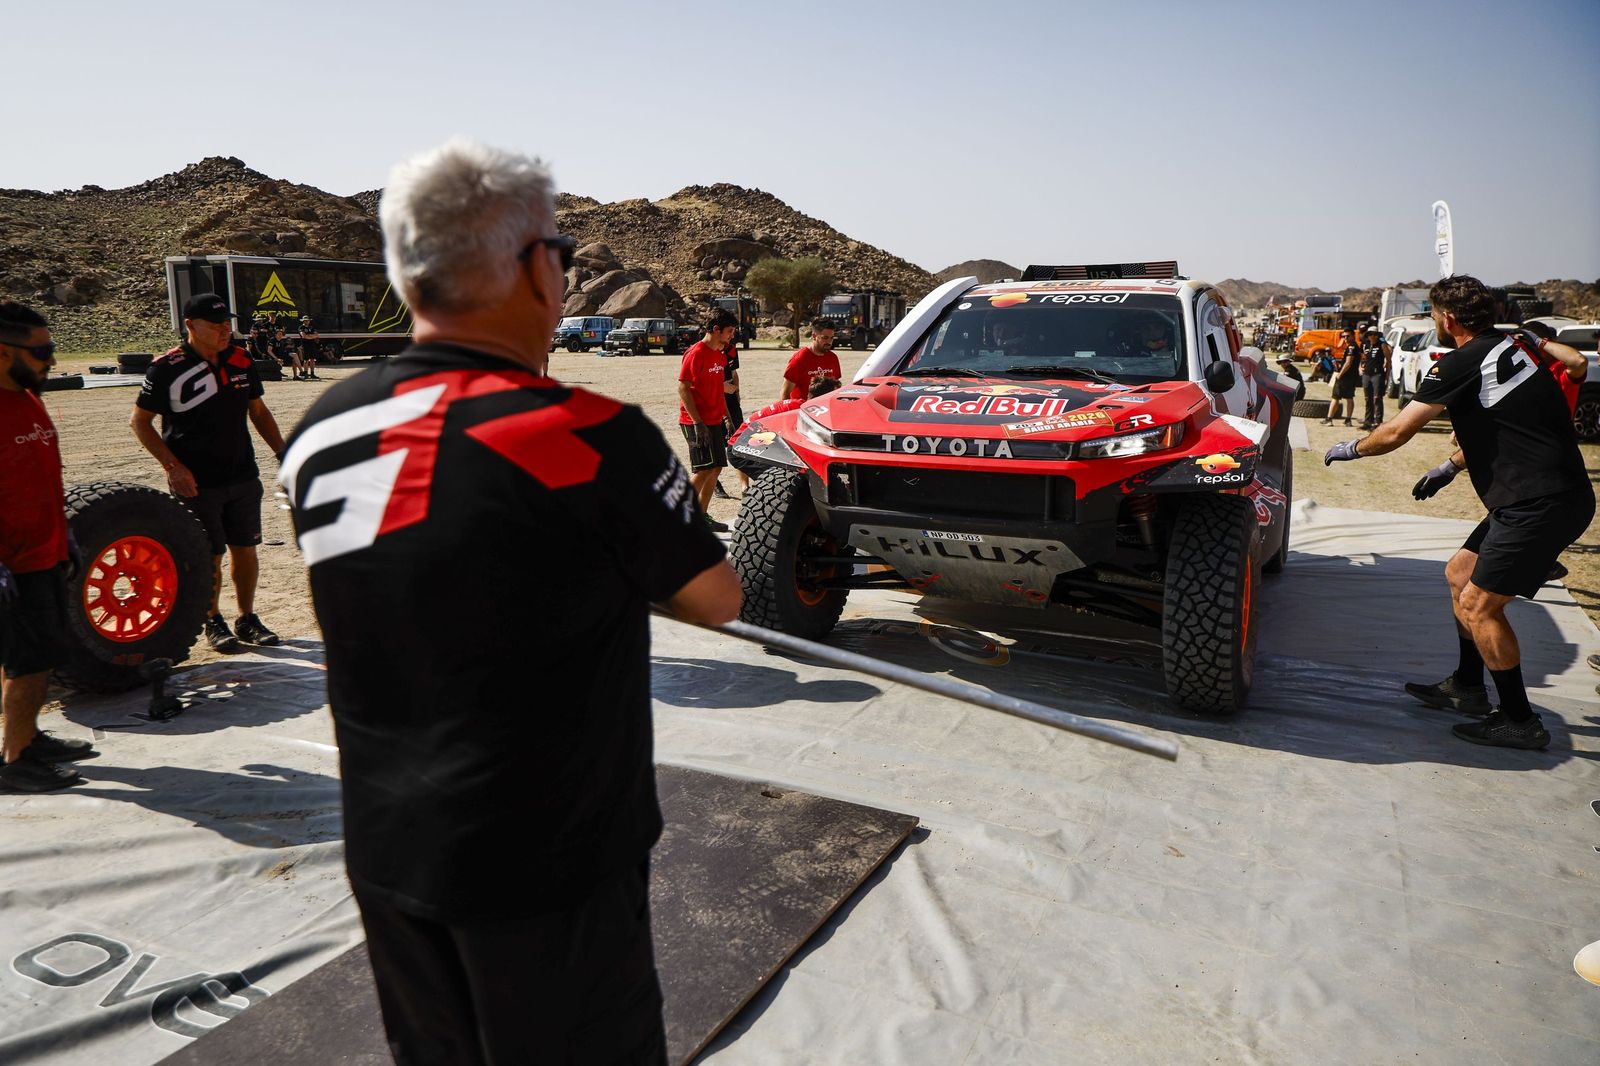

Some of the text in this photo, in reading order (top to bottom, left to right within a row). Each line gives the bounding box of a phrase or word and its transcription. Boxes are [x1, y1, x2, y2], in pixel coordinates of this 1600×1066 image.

[1090, 270, 1119, 280] USA
[1039, 292, 1130, 305] repsol
[909, 395, 1069, 417] Red Bull
[1068, 411, 1106, 421] 2026
[1114, 413, 1155, 432] GR
[1023, 419, 1095, 434] SAUDI ARABIA
[733, 444, 765, 456] repsol
[881, 435, 1013, 458] TOYOTA
[1195, 473, 1244, 484] repsol
[876, 536, 1047, 566] HILUX
